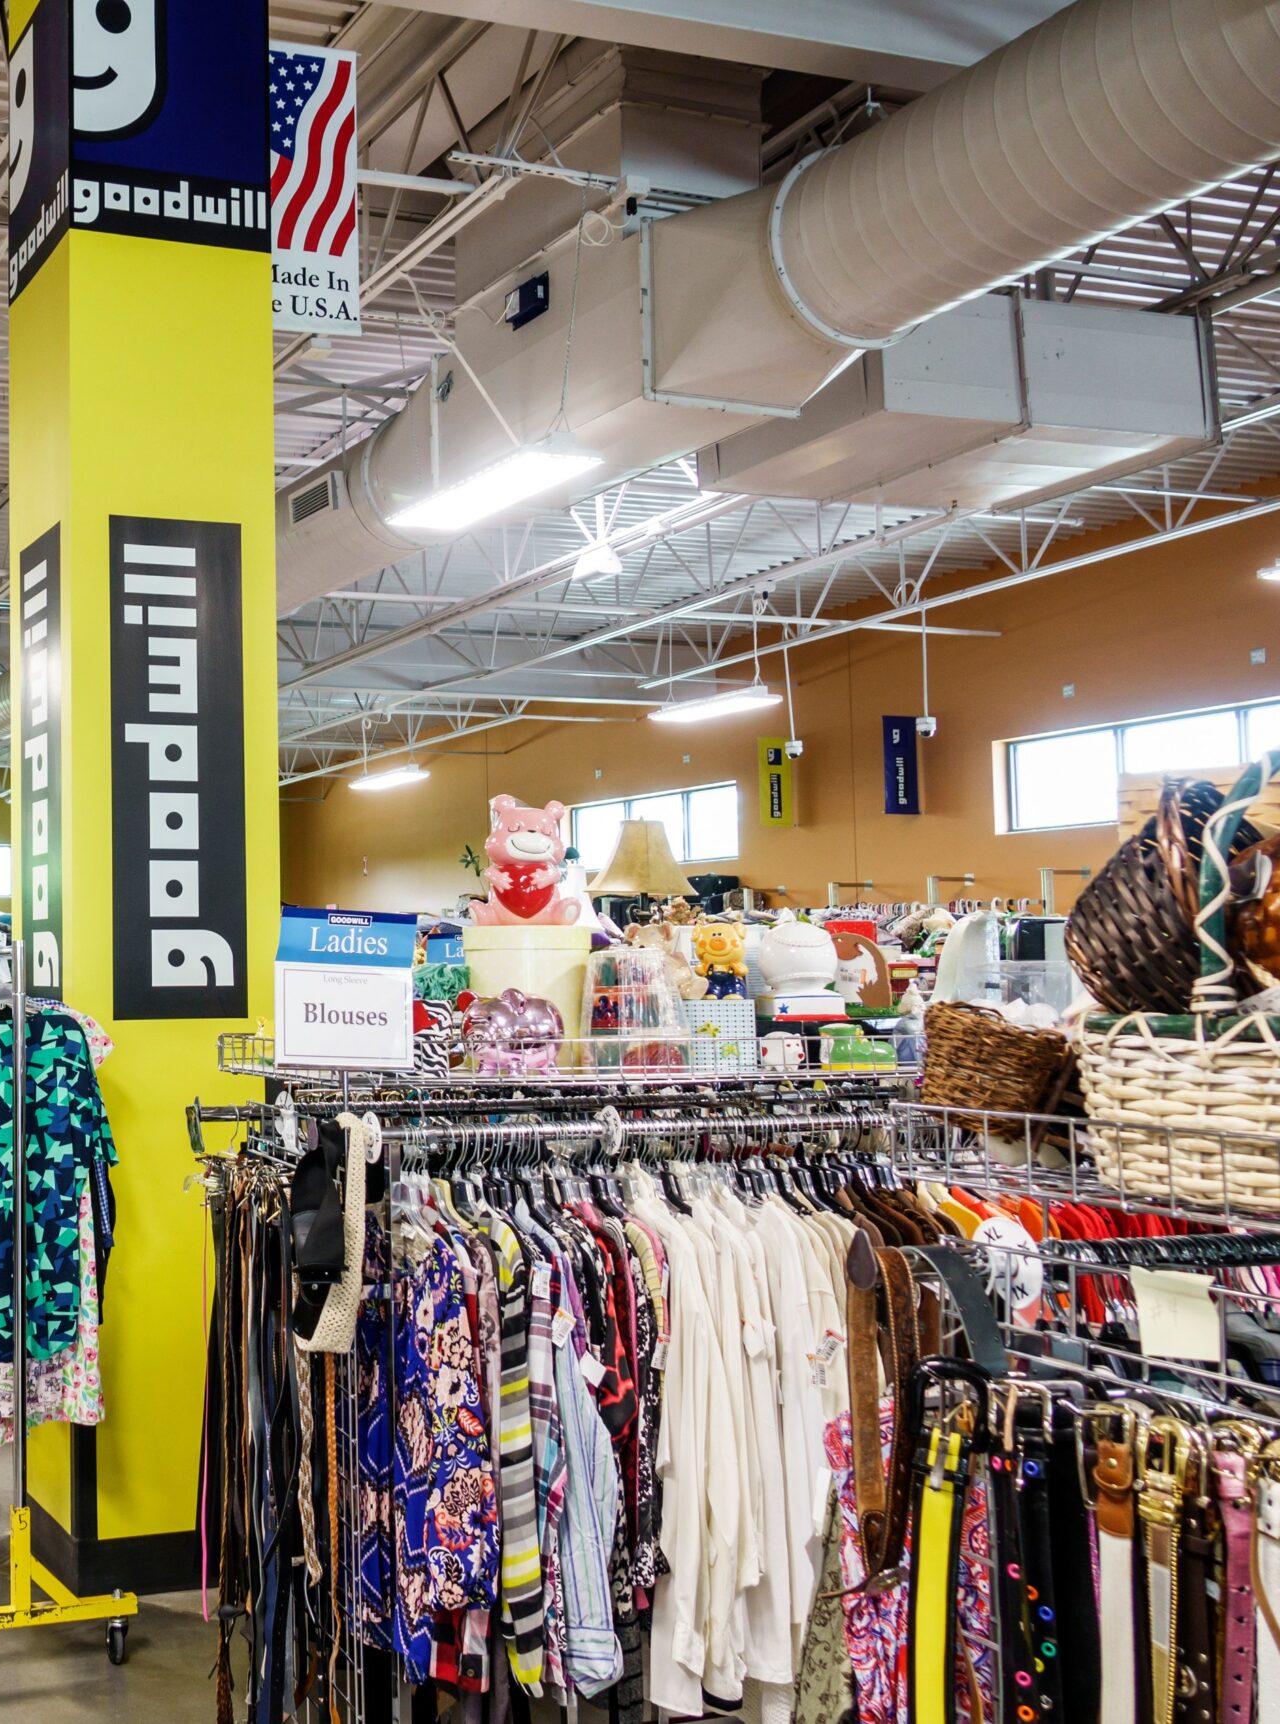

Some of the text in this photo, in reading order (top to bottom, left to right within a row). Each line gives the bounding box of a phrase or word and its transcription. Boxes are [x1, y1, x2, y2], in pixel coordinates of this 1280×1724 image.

[74, 179, 266, 229] goodwill
[10, 168, 68, 299] goodwill
[327, 270, 350, 292] In
[290, 295, 358, 321] U.S.A.
[24, 559, 59, 987] goodwill
[124, 543, 235, 987] goodwill
[771, 775, 781, 817] goodwill
[896, 757, 907, 805] goodwill
[331, 916, 369, 926] GOODWILL
[308, 926, 388, 956] Ladies
[324, 974, 368, 985] Long Sleeve
[304, 1002, 388, 1027] Blouses
[984, 1227, 1003, 1245] XL
